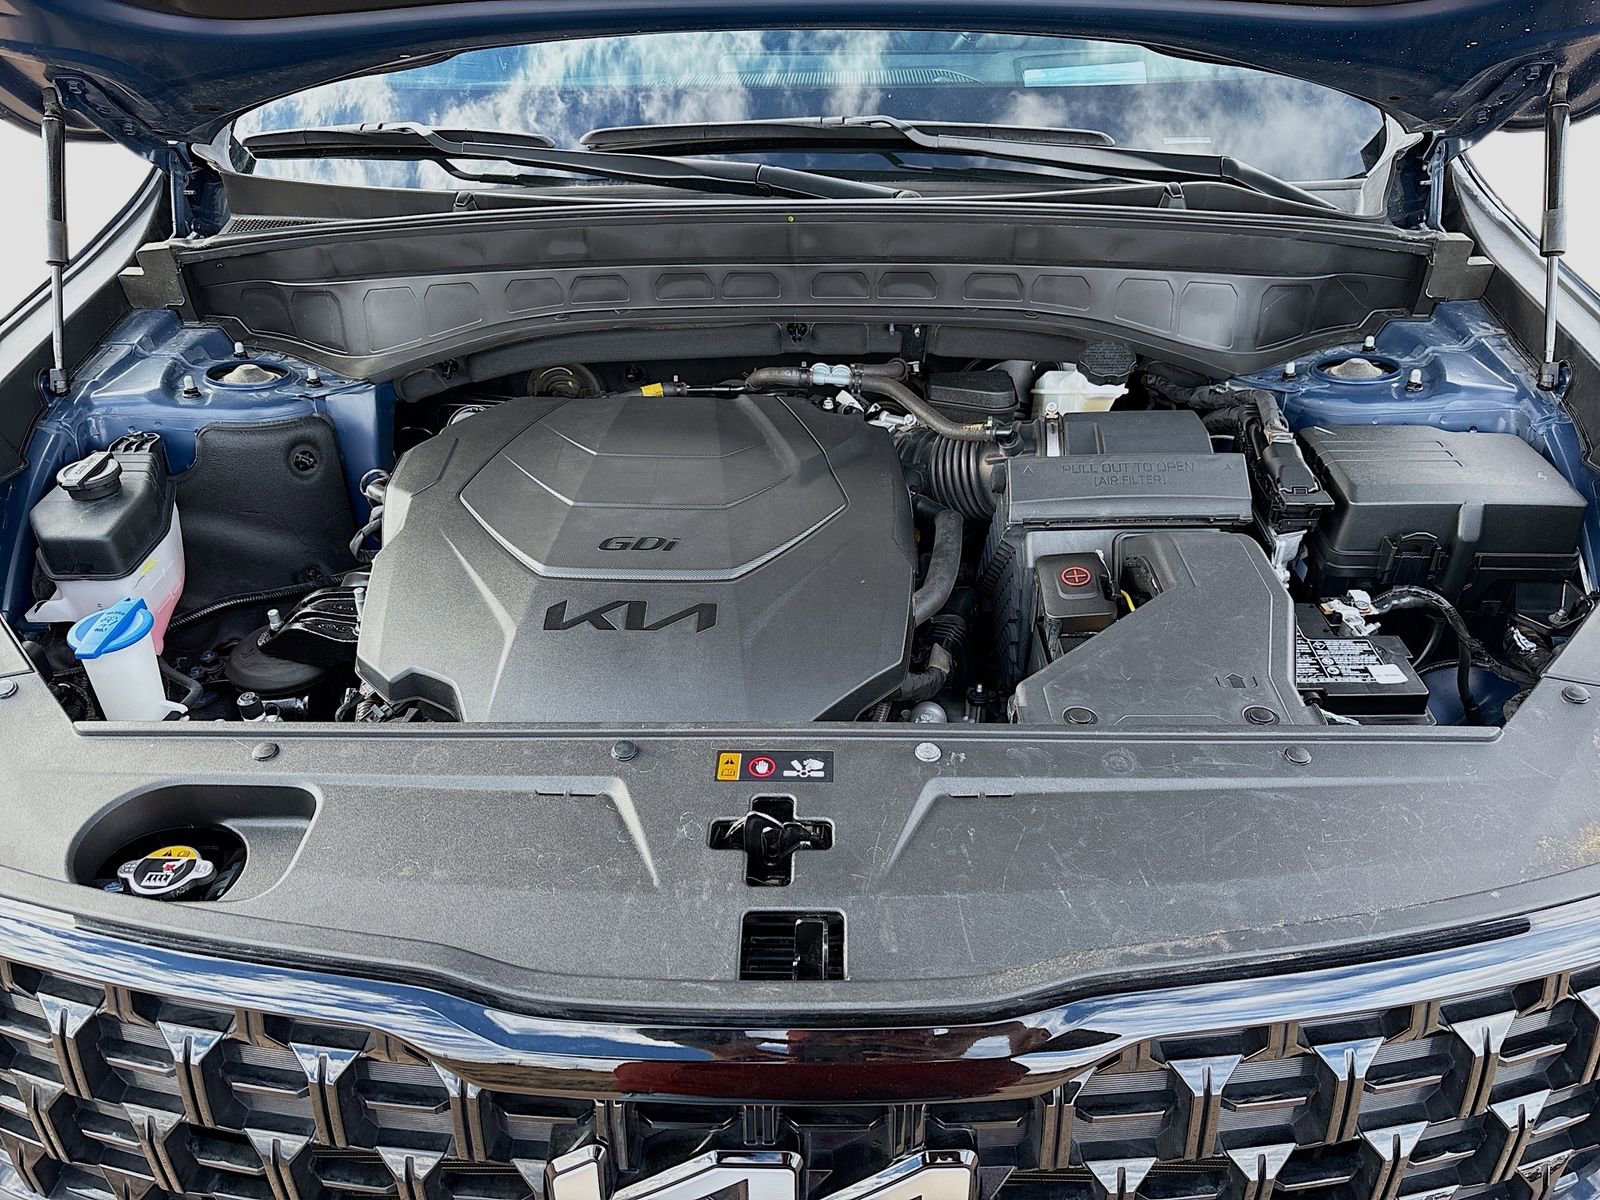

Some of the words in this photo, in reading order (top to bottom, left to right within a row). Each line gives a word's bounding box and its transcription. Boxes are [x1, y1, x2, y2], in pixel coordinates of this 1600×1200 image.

[1062, 463, 1098, 474] PULL
[1101, 462, 1129, 473] OUT
[1134, 462, 1153, 473] TO
[1157, 461, 1195, 472] OPEN
[597, 536, 681, 551] GDi
[543, 600, 718, 633] KIA
